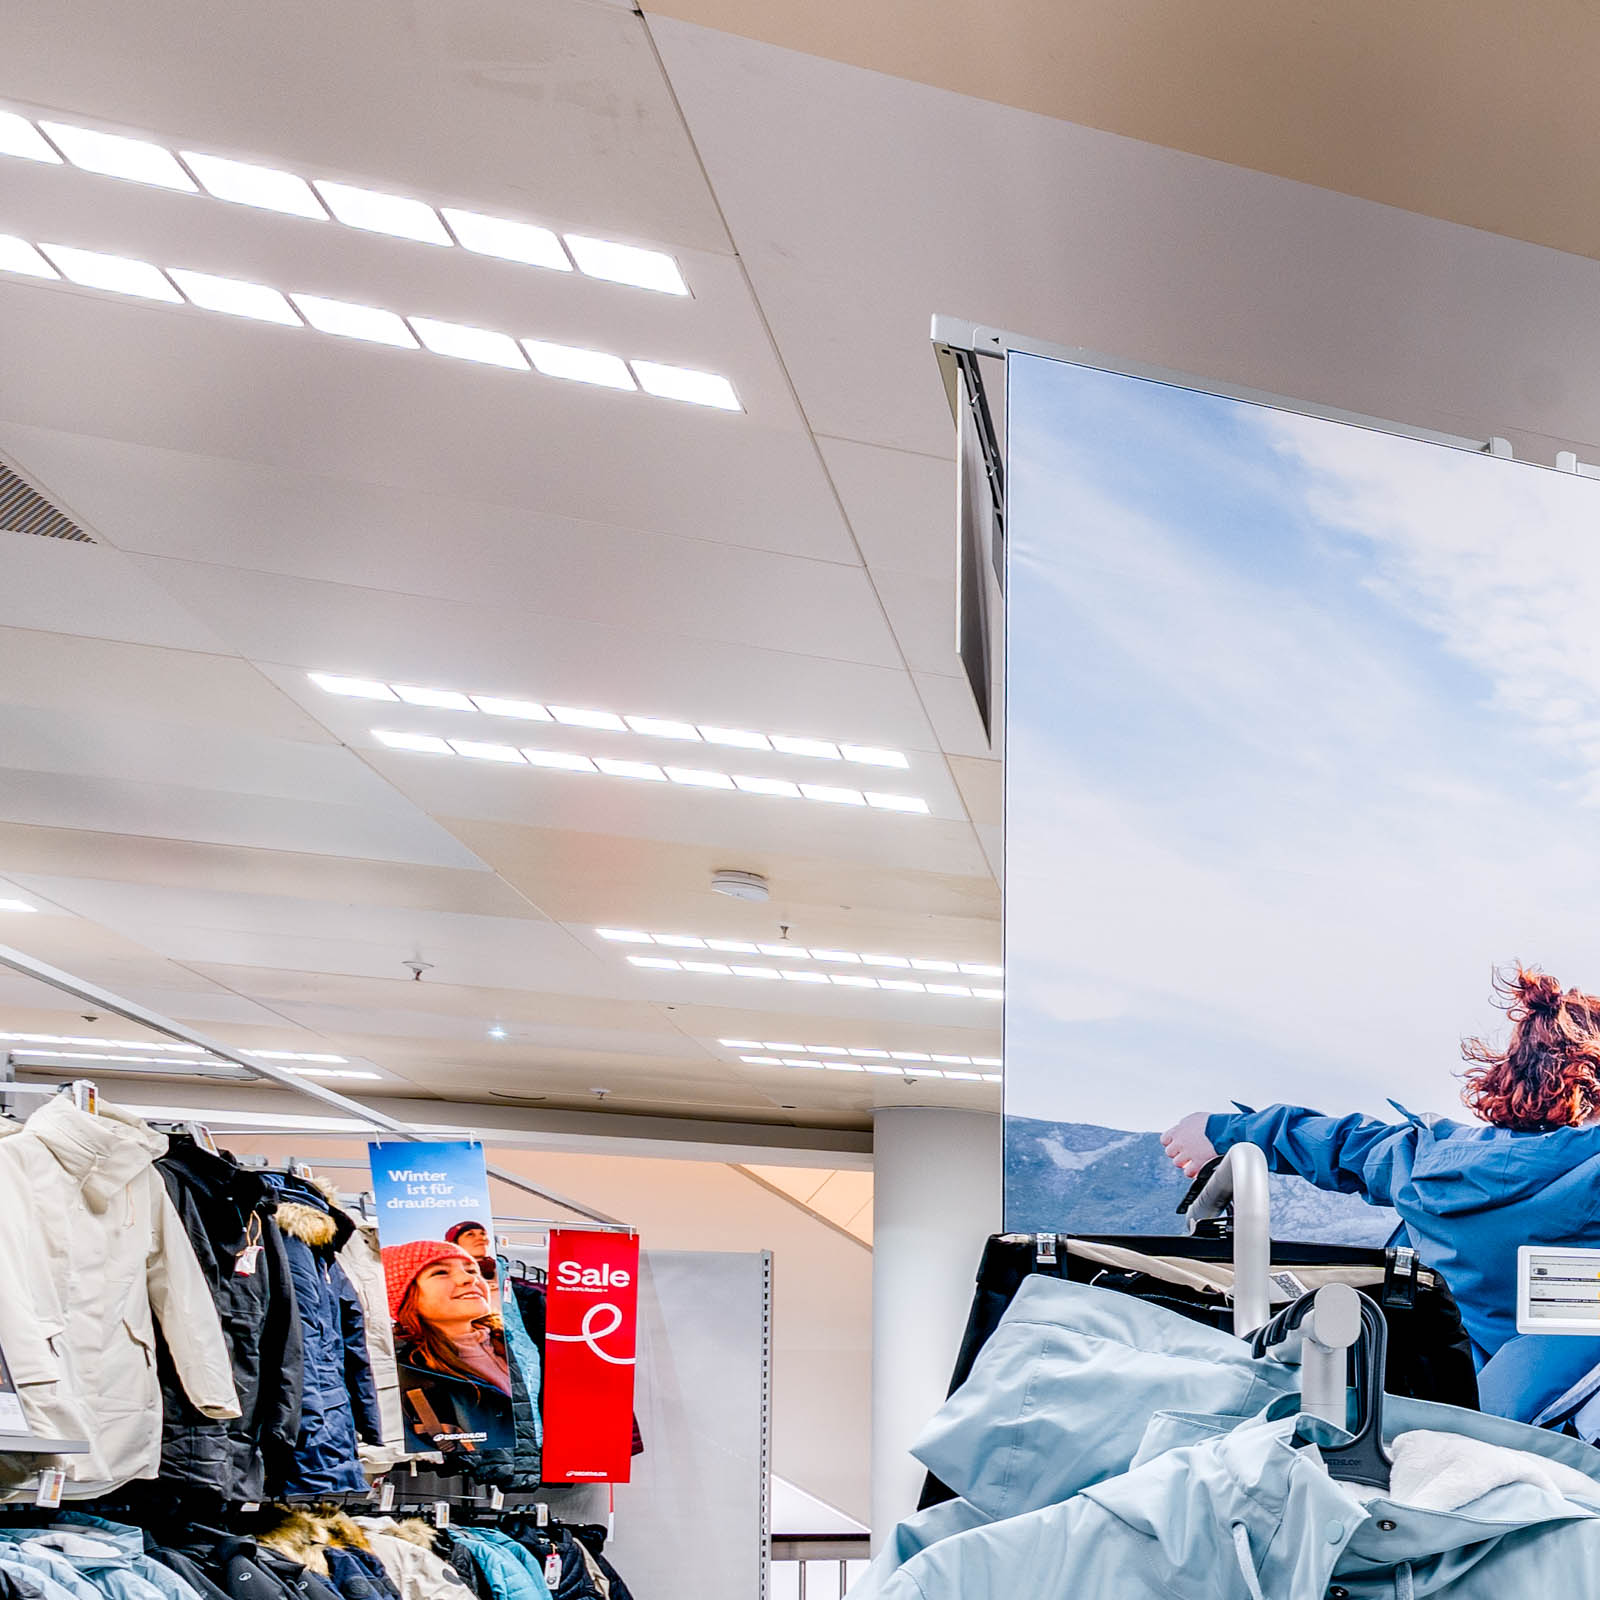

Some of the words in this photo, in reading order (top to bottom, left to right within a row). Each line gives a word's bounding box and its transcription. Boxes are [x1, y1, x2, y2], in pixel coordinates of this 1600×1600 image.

[387, 1169, 447, 1182] Winter
[406, 1184, 428, 1195] ist
[429, 1183, 455, 1195] für
[386, 1197, 457, 1209] draußen
[458, 1195, 480, 1208] da
[556, 1260, 631, 1288] Sale
